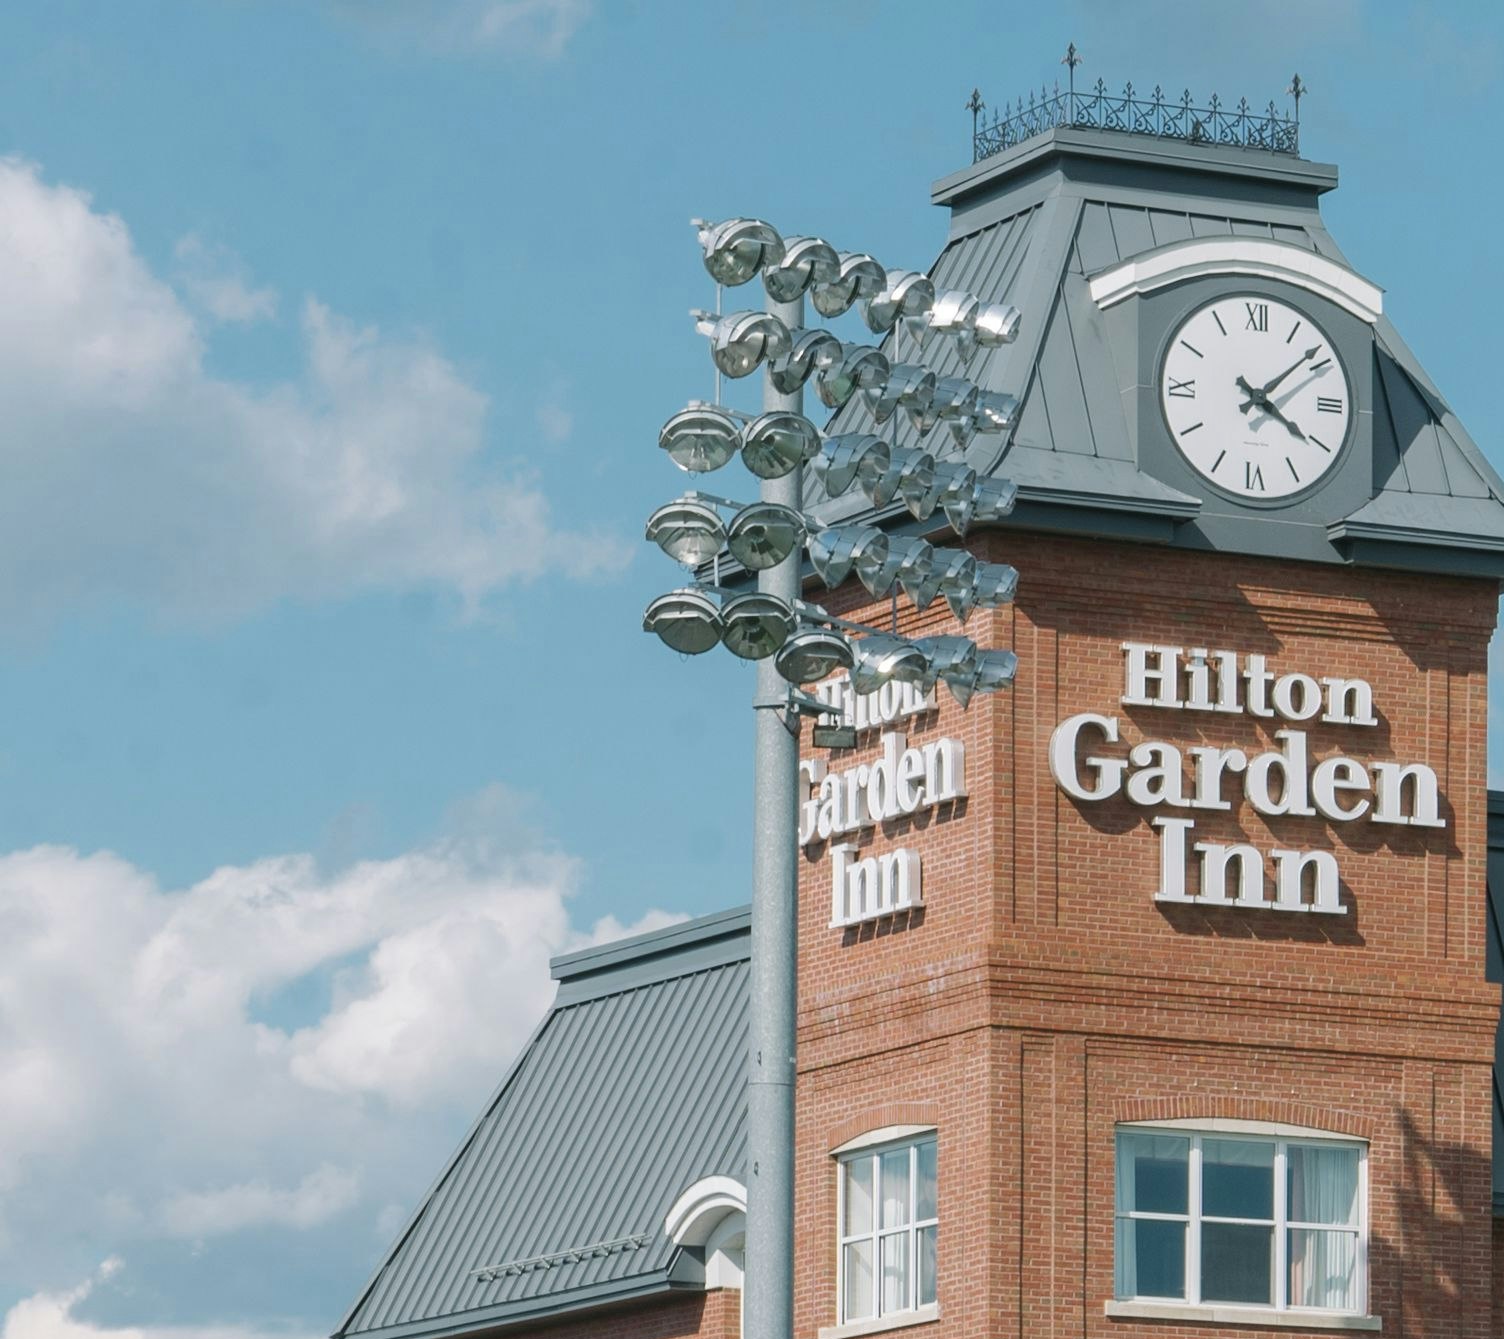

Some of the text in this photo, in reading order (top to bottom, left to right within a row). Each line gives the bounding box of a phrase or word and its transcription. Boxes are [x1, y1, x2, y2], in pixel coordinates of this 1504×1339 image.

[1245, 302, 1269, 332] XII
[1118, 640, 1378, 727] Hilton
[1049, 712, 1446, 828] Garden
[828, 842, 925, 929] Inn
[1152, 815, 1347, 915] Inn
